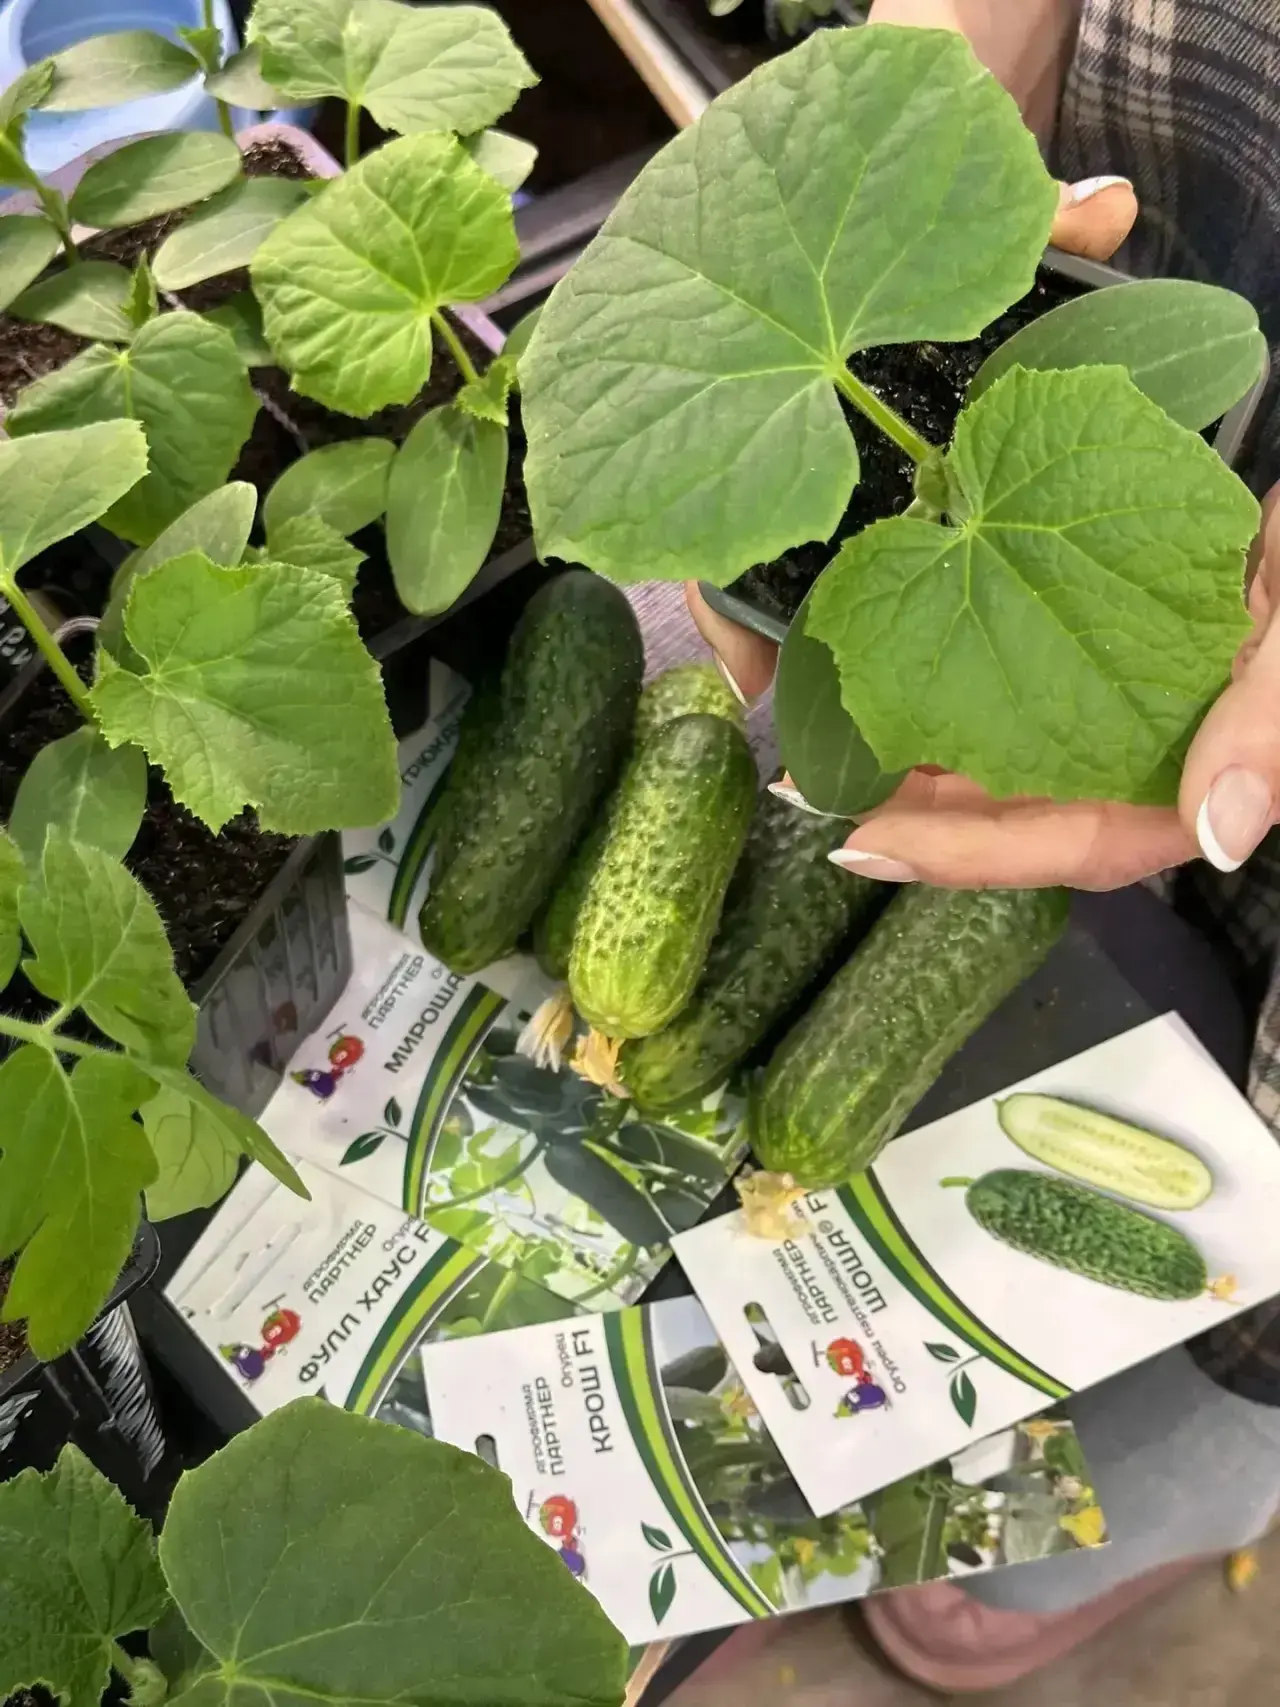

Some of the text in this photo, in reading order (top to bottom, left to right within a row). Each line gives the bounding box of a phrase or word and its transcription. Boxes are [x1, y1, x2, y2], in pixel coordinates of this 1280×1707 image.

[367, 955, 424, 1030] ПАРТНЕР
[384, 972, 466, 1074] МИРОША
[303, 1219, 364, 1292] АГРОФИРМА
[308, 1223, 377, 1304] ПАРТНЕР
[382, 1214, 418, 1251] Огуре
[298, 1222, 432, 1384] ФУЛЛ ХАУС F
[773, 1247, 821, 1326] АГРОФИРМА
[783, 1238, 839, 1324] ПАРТНЕР
[555, 1332, 573, 1388] Огурец
[571, 1329, 614, 1454] КРОШ F1
[872, 1339, 906, 1394] Огурец
[522, 1383, 546, 1474] АГРОФИРМА
[535, 1376, 566, 1476] ПАРТНЕР
